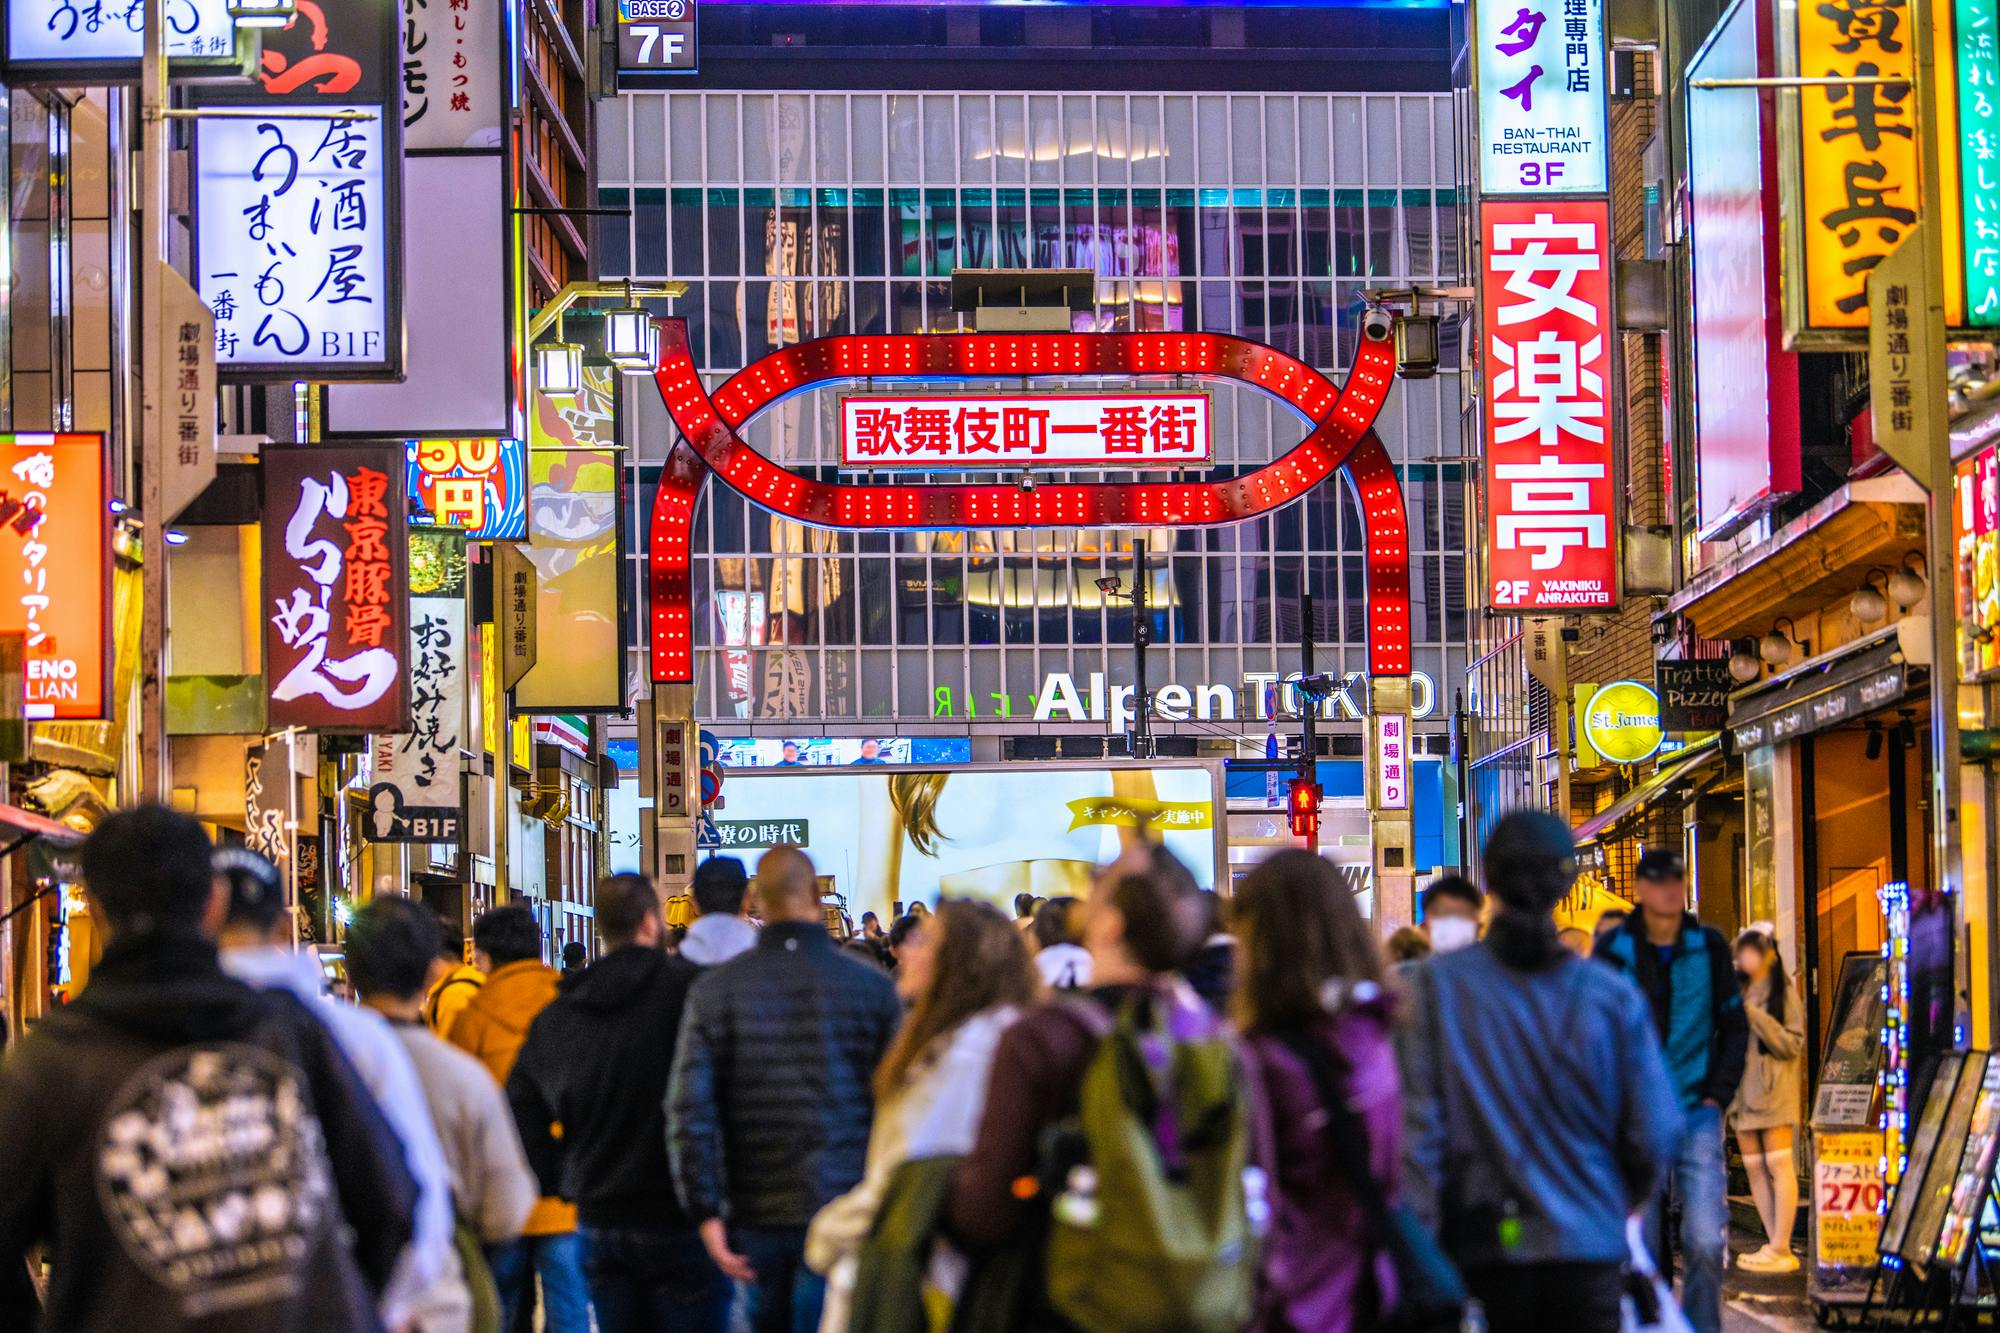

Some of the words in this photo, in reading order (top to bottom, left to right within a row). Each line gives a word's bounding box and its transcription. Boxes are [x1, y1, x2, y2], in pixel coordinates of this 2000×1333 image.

[169, 36, 227, 54] 一番街
[630, 26, 684, 63] 7F
[1493, 142, 1591, 154] RESTAURANT
[1504, 127, 1580, 140] BAN-THAI
[1520, 162, 1565, 186] 3F
[307, 109, 372, 304] 居酒屋
[243, 123, 310, 356] うまいもん
[211, 272, 240, 358] 一番街
[321, 331, 379, 357] B1F
[1886, 285, 1913, 431] 劇場通り一番街
[178, 322, 200, 466] 劇場通り一番街
[1490, 213, 1607, 570] 安楽亭
[855, 406, 1197, 454] 歌舞伎町一番街
[343, 466, 391, 646] 東京豚骨
[1495, 581, 1529, 604] 2F
[1535, 592, 1609, 603] ANRAKUTEI
[1542, 580, 1601, 591] YAKINIKU
[402, 614, 456, 787] お好み焼き
[1033, 672, 1236, 734] Alpen
[665, 728, 682, 808] 劇場通り
[1383, 721, 1401, 801] 劇場通り
[412, 818, 457, 838] B1F
